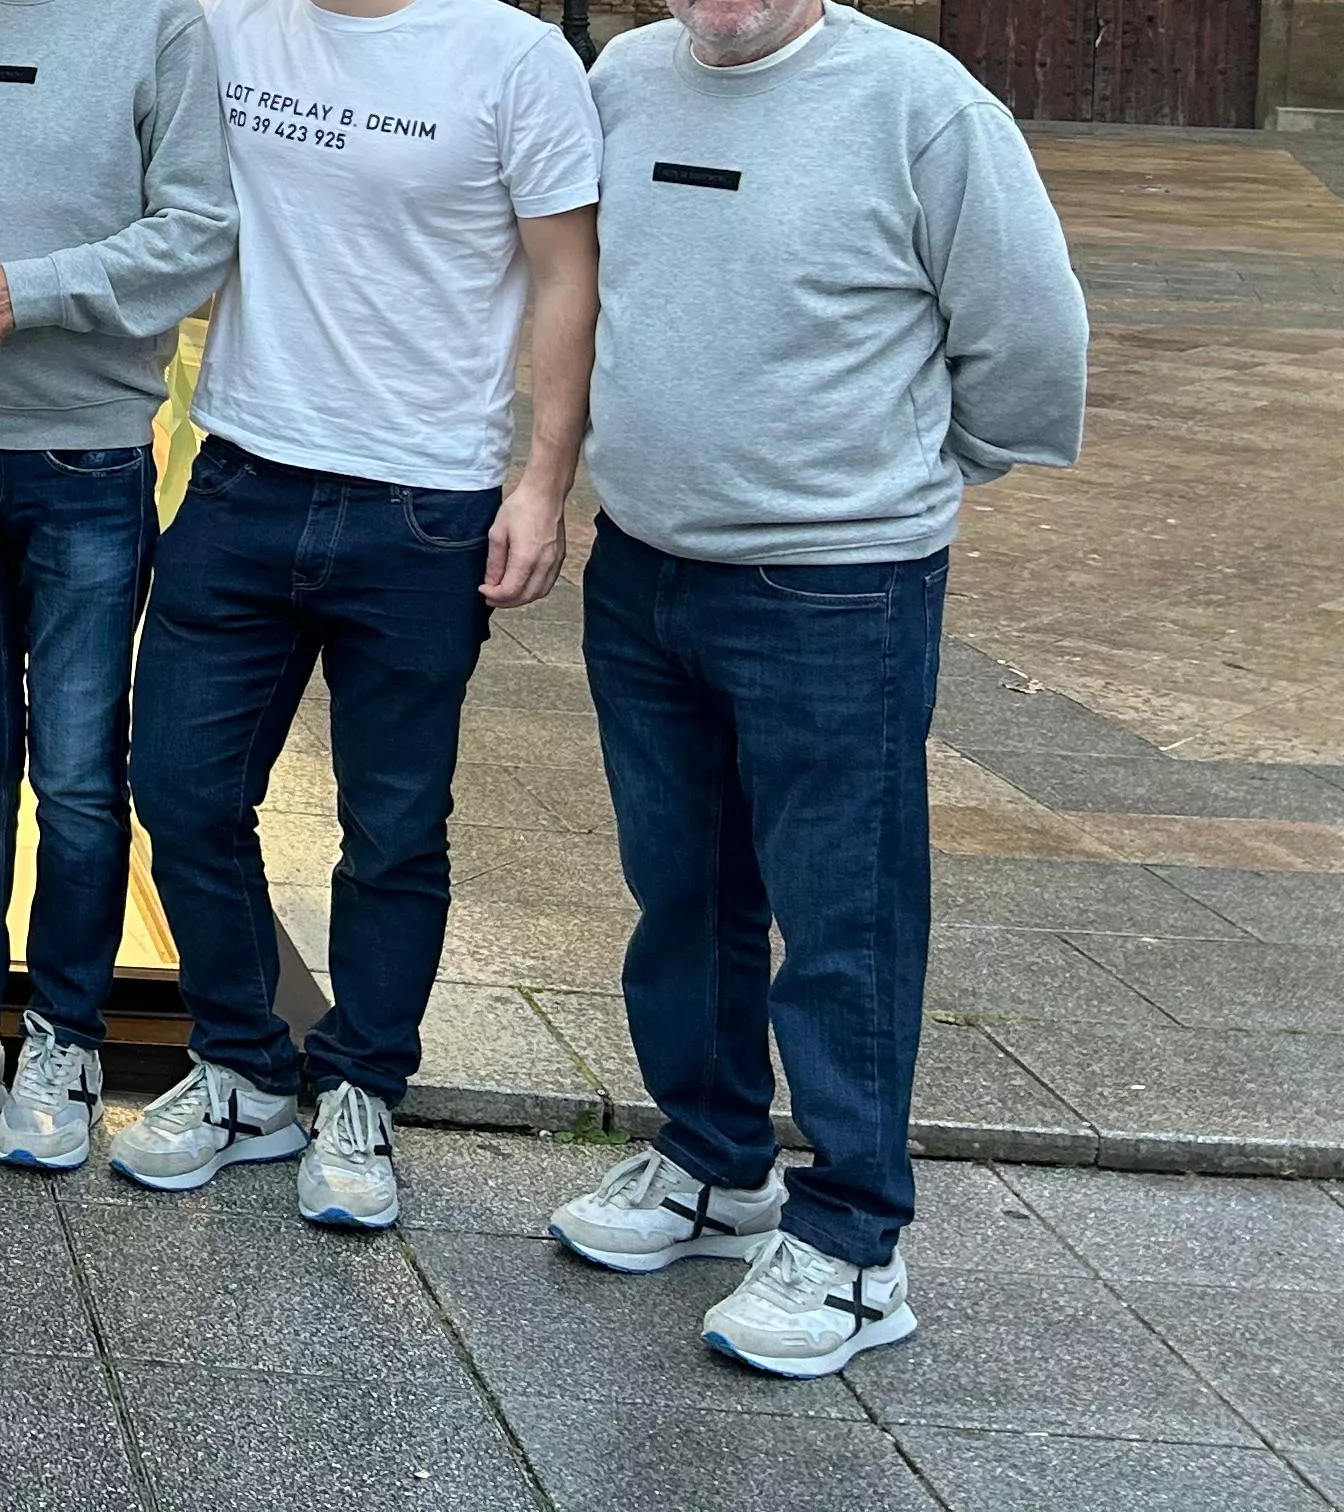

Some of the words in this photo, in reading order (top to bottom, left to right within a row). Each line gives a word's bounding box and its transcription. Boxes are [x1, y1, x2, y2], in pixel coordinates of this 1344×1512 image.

[226, 81, 254, 103] LOT
[258, 91, 333, 121] REPLAY
[366, 113, 437, 141] DENIM
[229, 108, 247, 128] RD
[252, 115, 271, 134] 39
[275, 120, 309, 142] 423
[315, 129, 346, 150] 925
